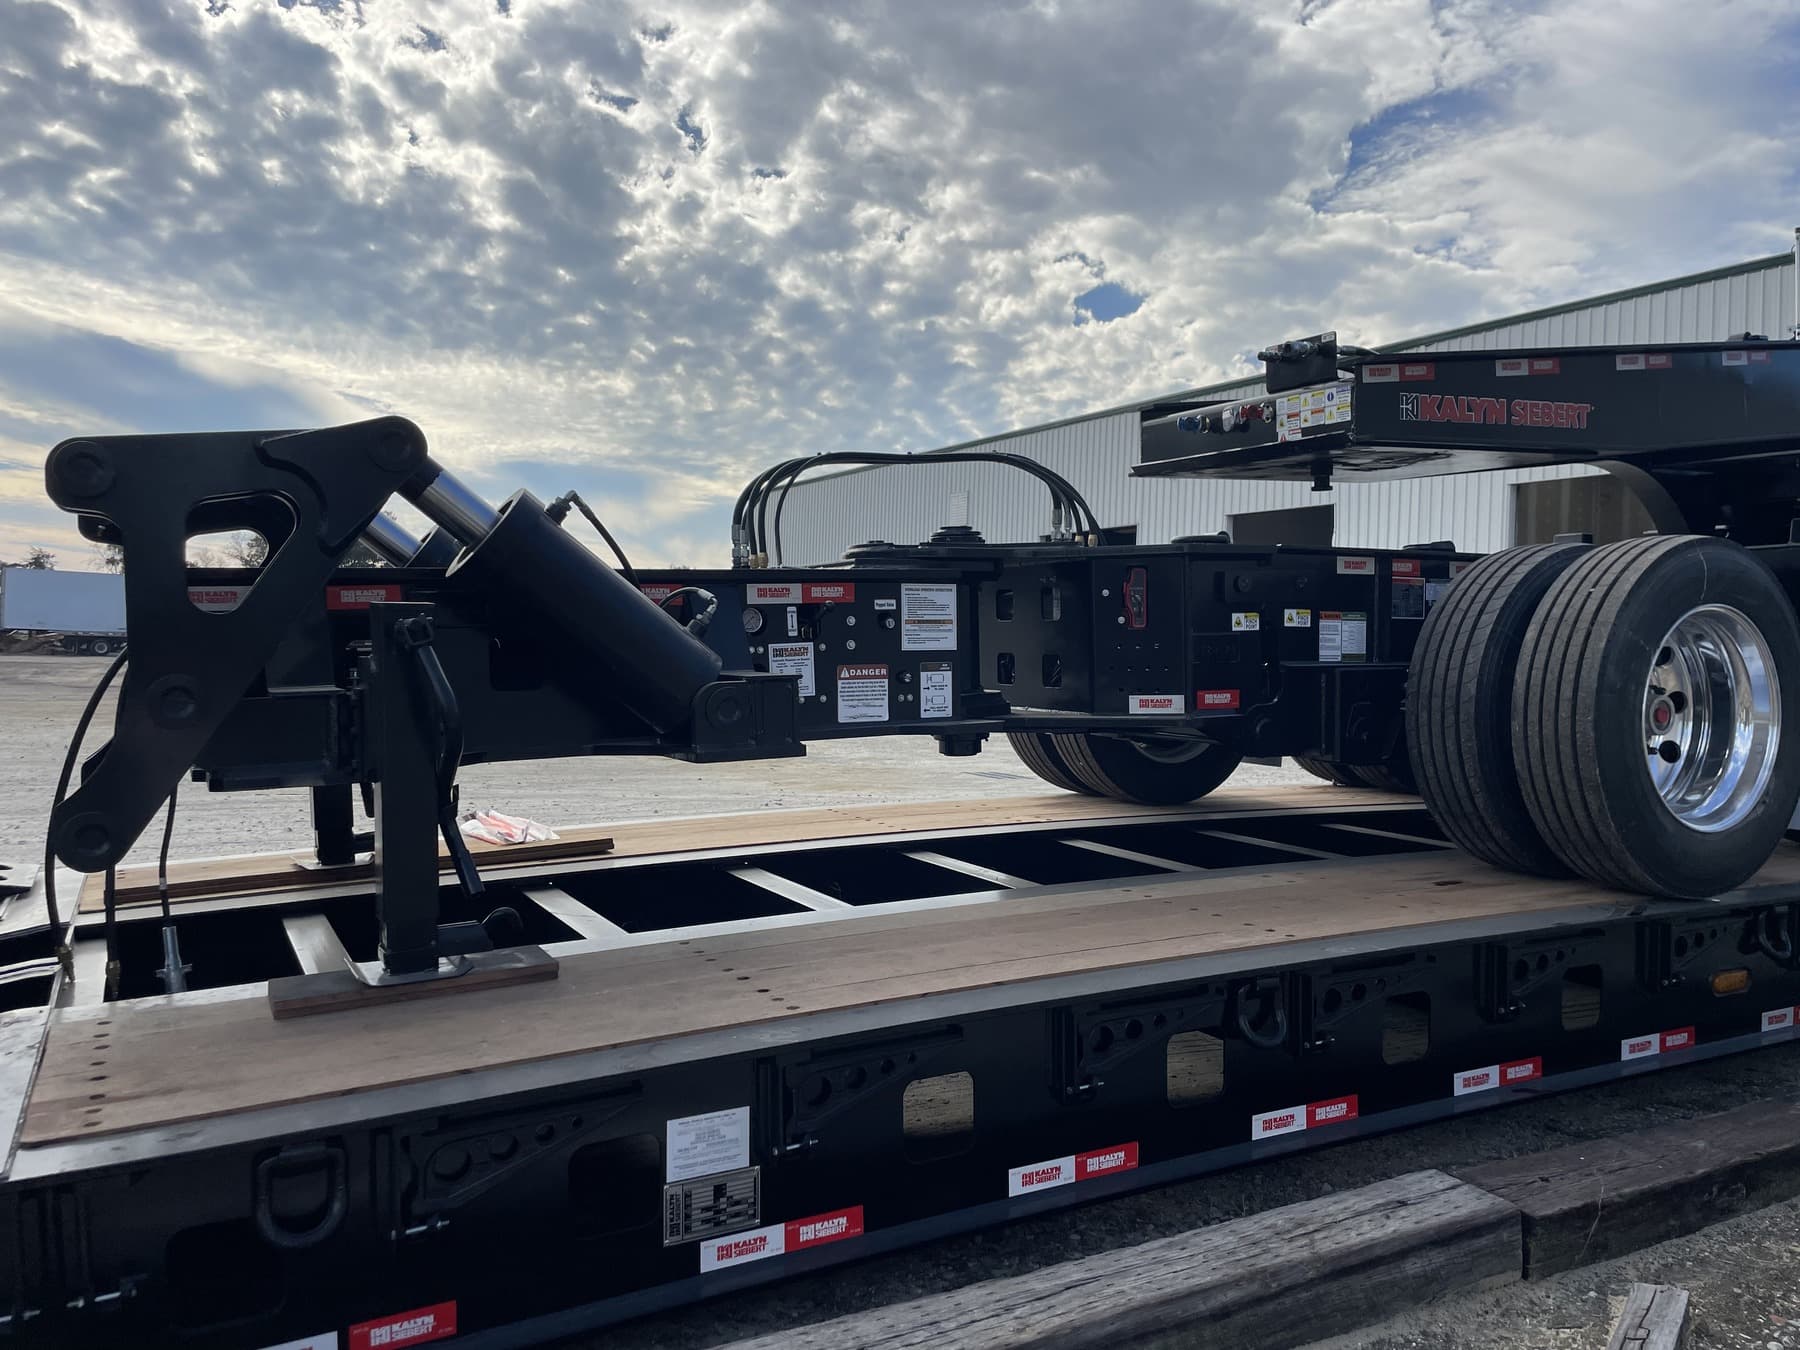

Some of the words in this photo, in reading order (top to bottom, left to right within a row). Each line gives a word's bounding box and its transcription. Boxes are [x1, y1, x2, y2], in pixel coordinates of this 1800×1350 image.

[1420, 394, 1507, 425] KALYN
[1511, 399, 1592, 429] SIEBERT
[849, 668, 887, 676] DANGER
[1325, 1102, 1348, 1112] KALYN
[1272, 1113, 1295, 1123] KALYN
[1099, 1151, 1126, 1162] KALYN
[1099, 1158, 1125, 1170] SIEBERT
[1034, 1165, 1062, 1177] KALYN
[1034, 1172, 1061, 1184] SIEBERT
[815, 1216, 848, 1231] KALYN
[815, 1224, 848, 1239] SIEBERT
[733, 1235, 768, 1250] KALYN
[733, 1243, 767, 1258] SIEBERT
[391, 1314, 435, 1332] KALYN
[391, 1322, 434, 1342] SIEBERT
